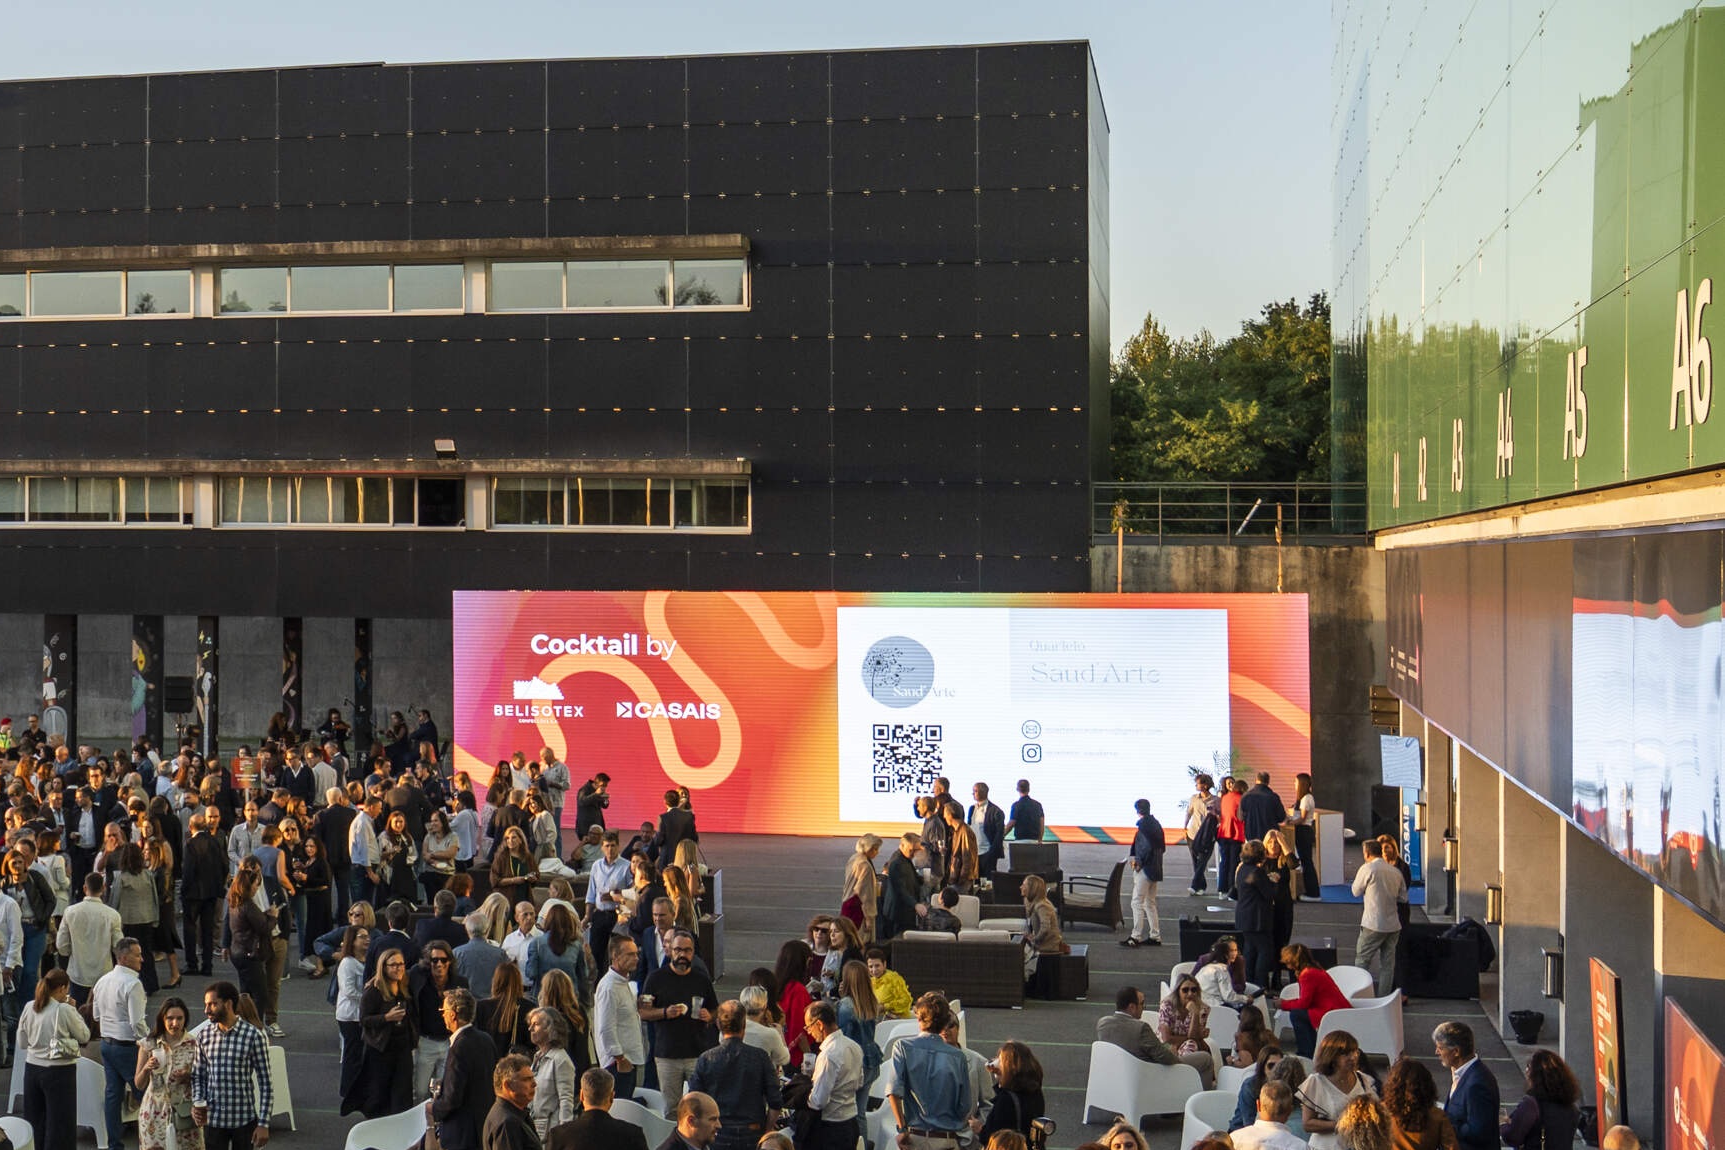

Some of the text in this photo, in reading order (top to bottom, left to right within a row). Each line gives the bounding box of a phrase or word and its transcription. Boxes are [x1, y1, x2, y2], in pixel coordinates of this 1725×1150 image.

[1669, 277, 1713, 431] A6
[1495, 386, 1515, 480] A4
[1563, 345, 1588, 461] A5
[1451, 417, 1464, 493] A3
[530, 632, 678, 662] Cocktail by
[493, 704, 585, 718] BELISOTEX
[634, 702, 722, 720] CASAIS
